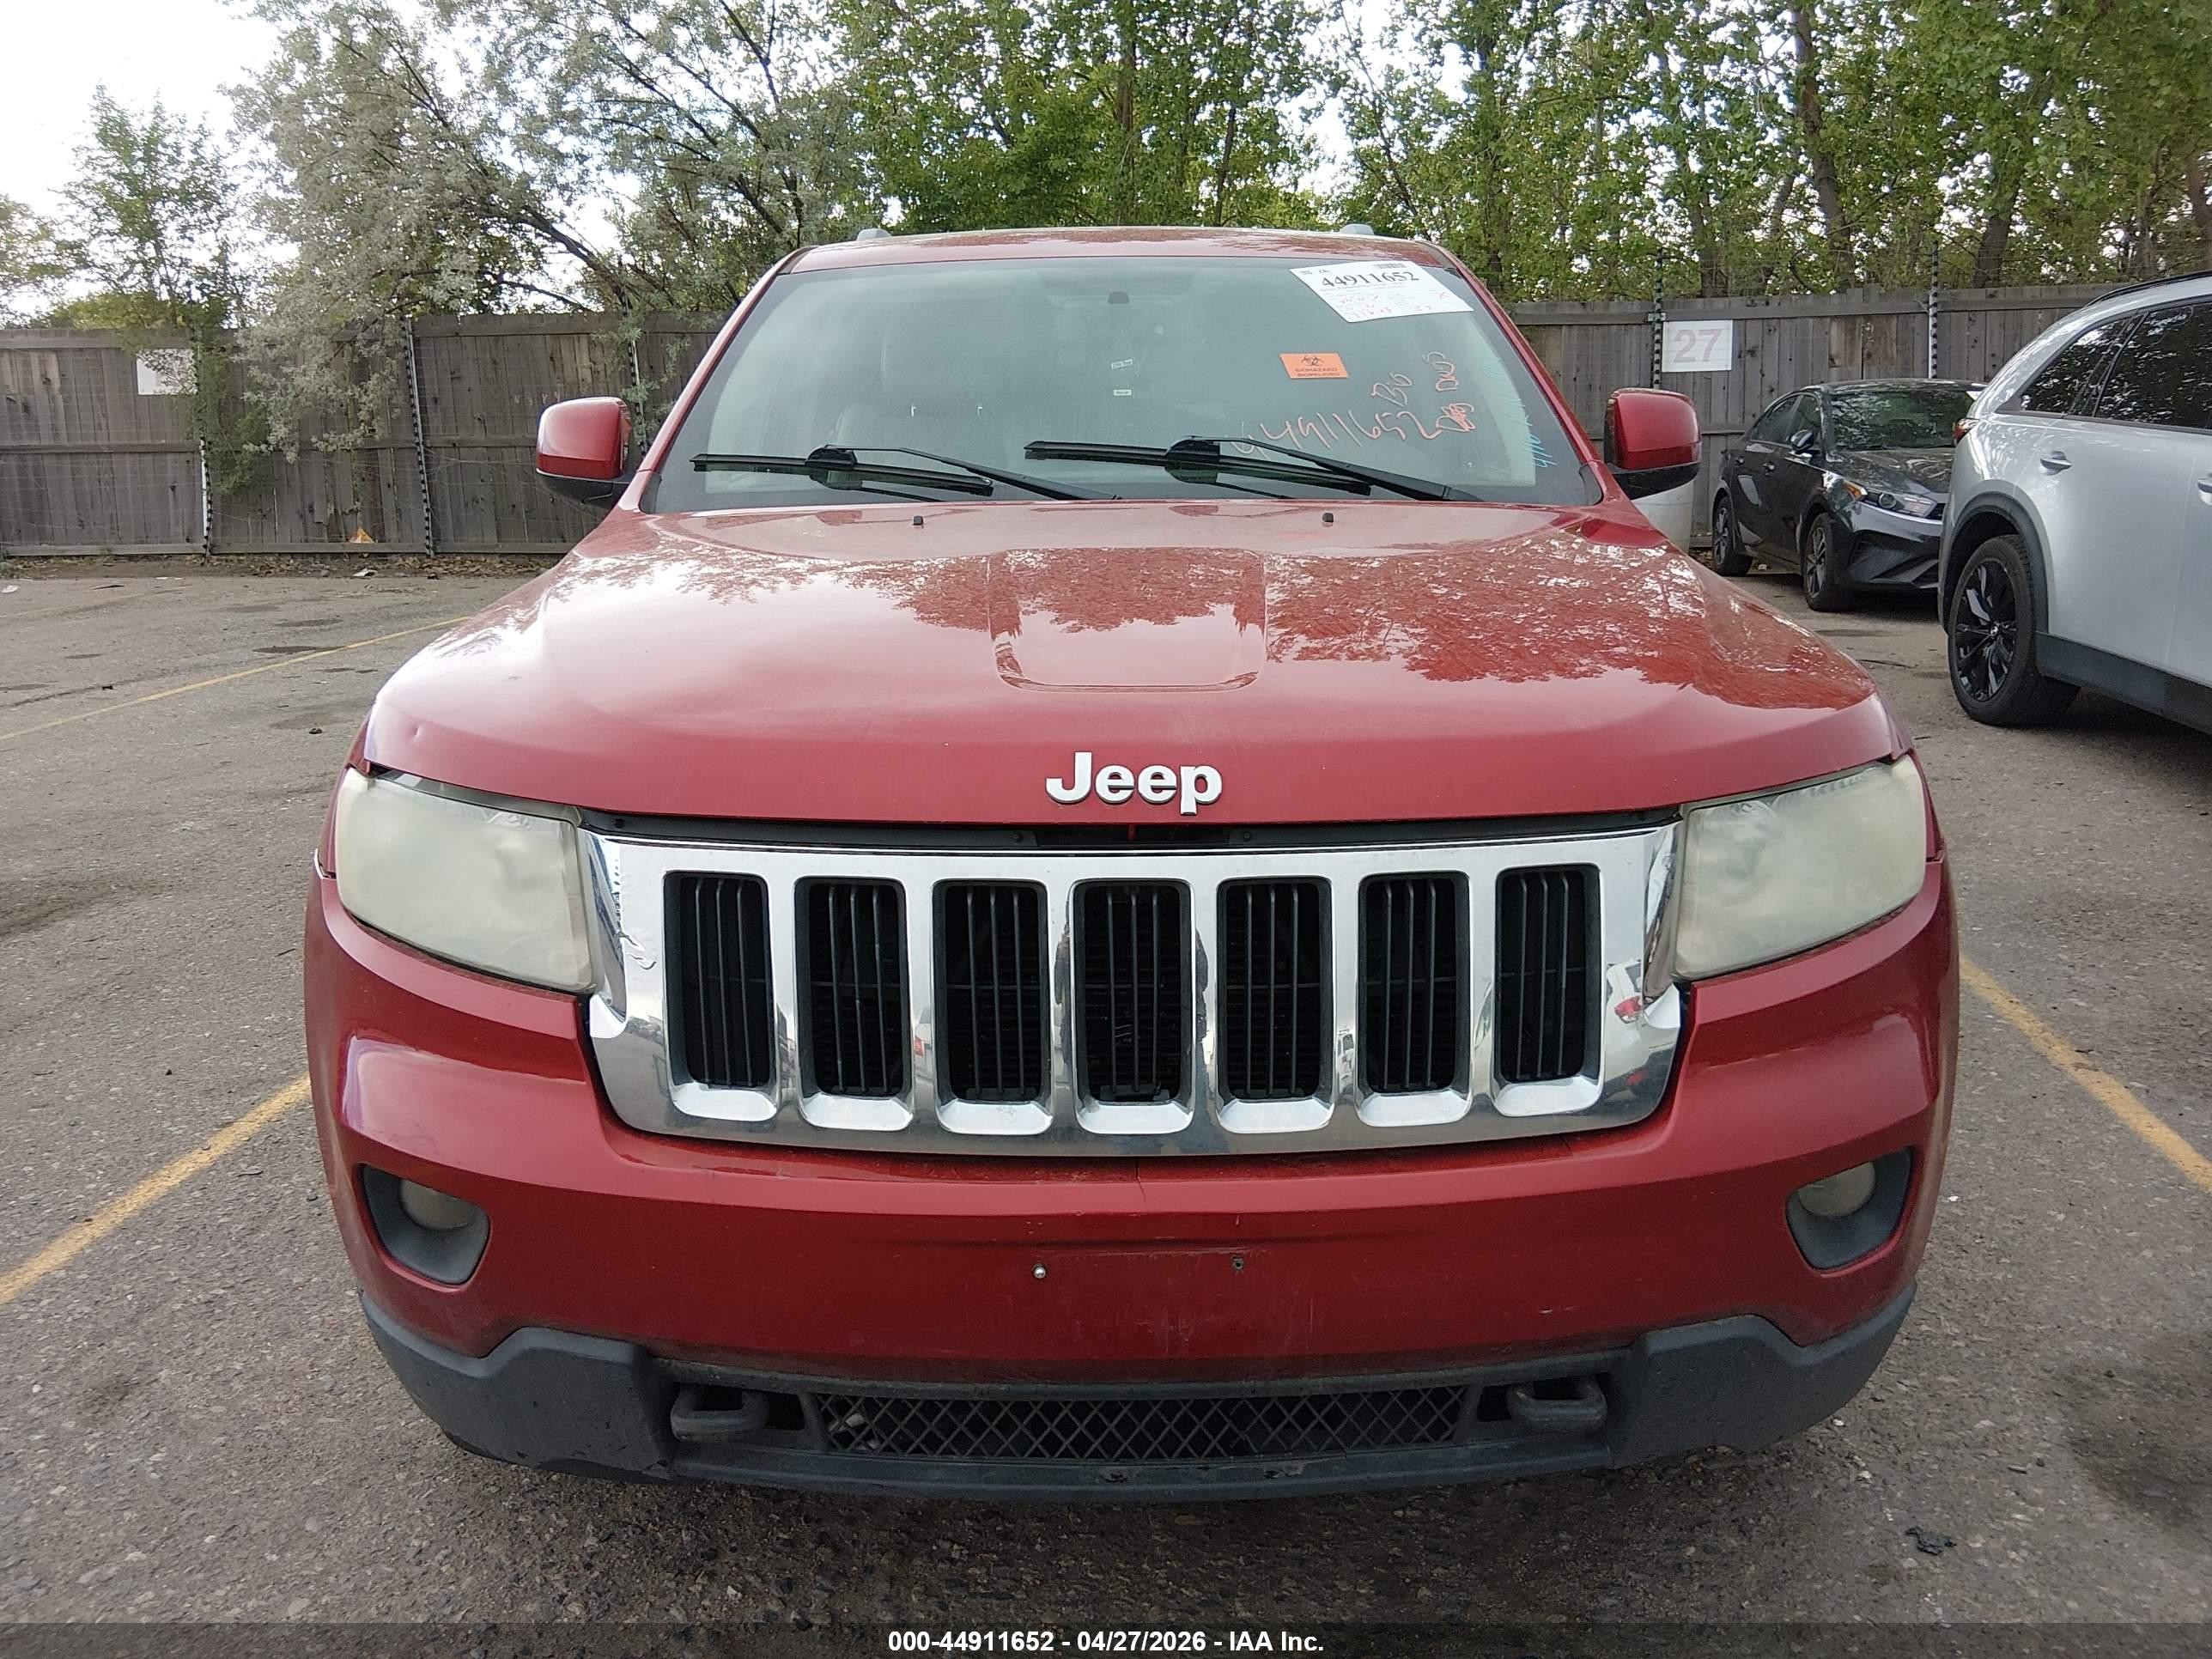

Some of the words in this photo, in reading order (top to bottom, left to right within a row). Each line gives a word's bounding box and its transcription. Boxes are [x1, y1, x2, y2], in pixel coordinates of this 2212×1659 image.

[1321, 270, 1420, 288] 44911652
[1674, 329, 1722, 363] 27
[1046, 751, 1223, 816] Jeep
